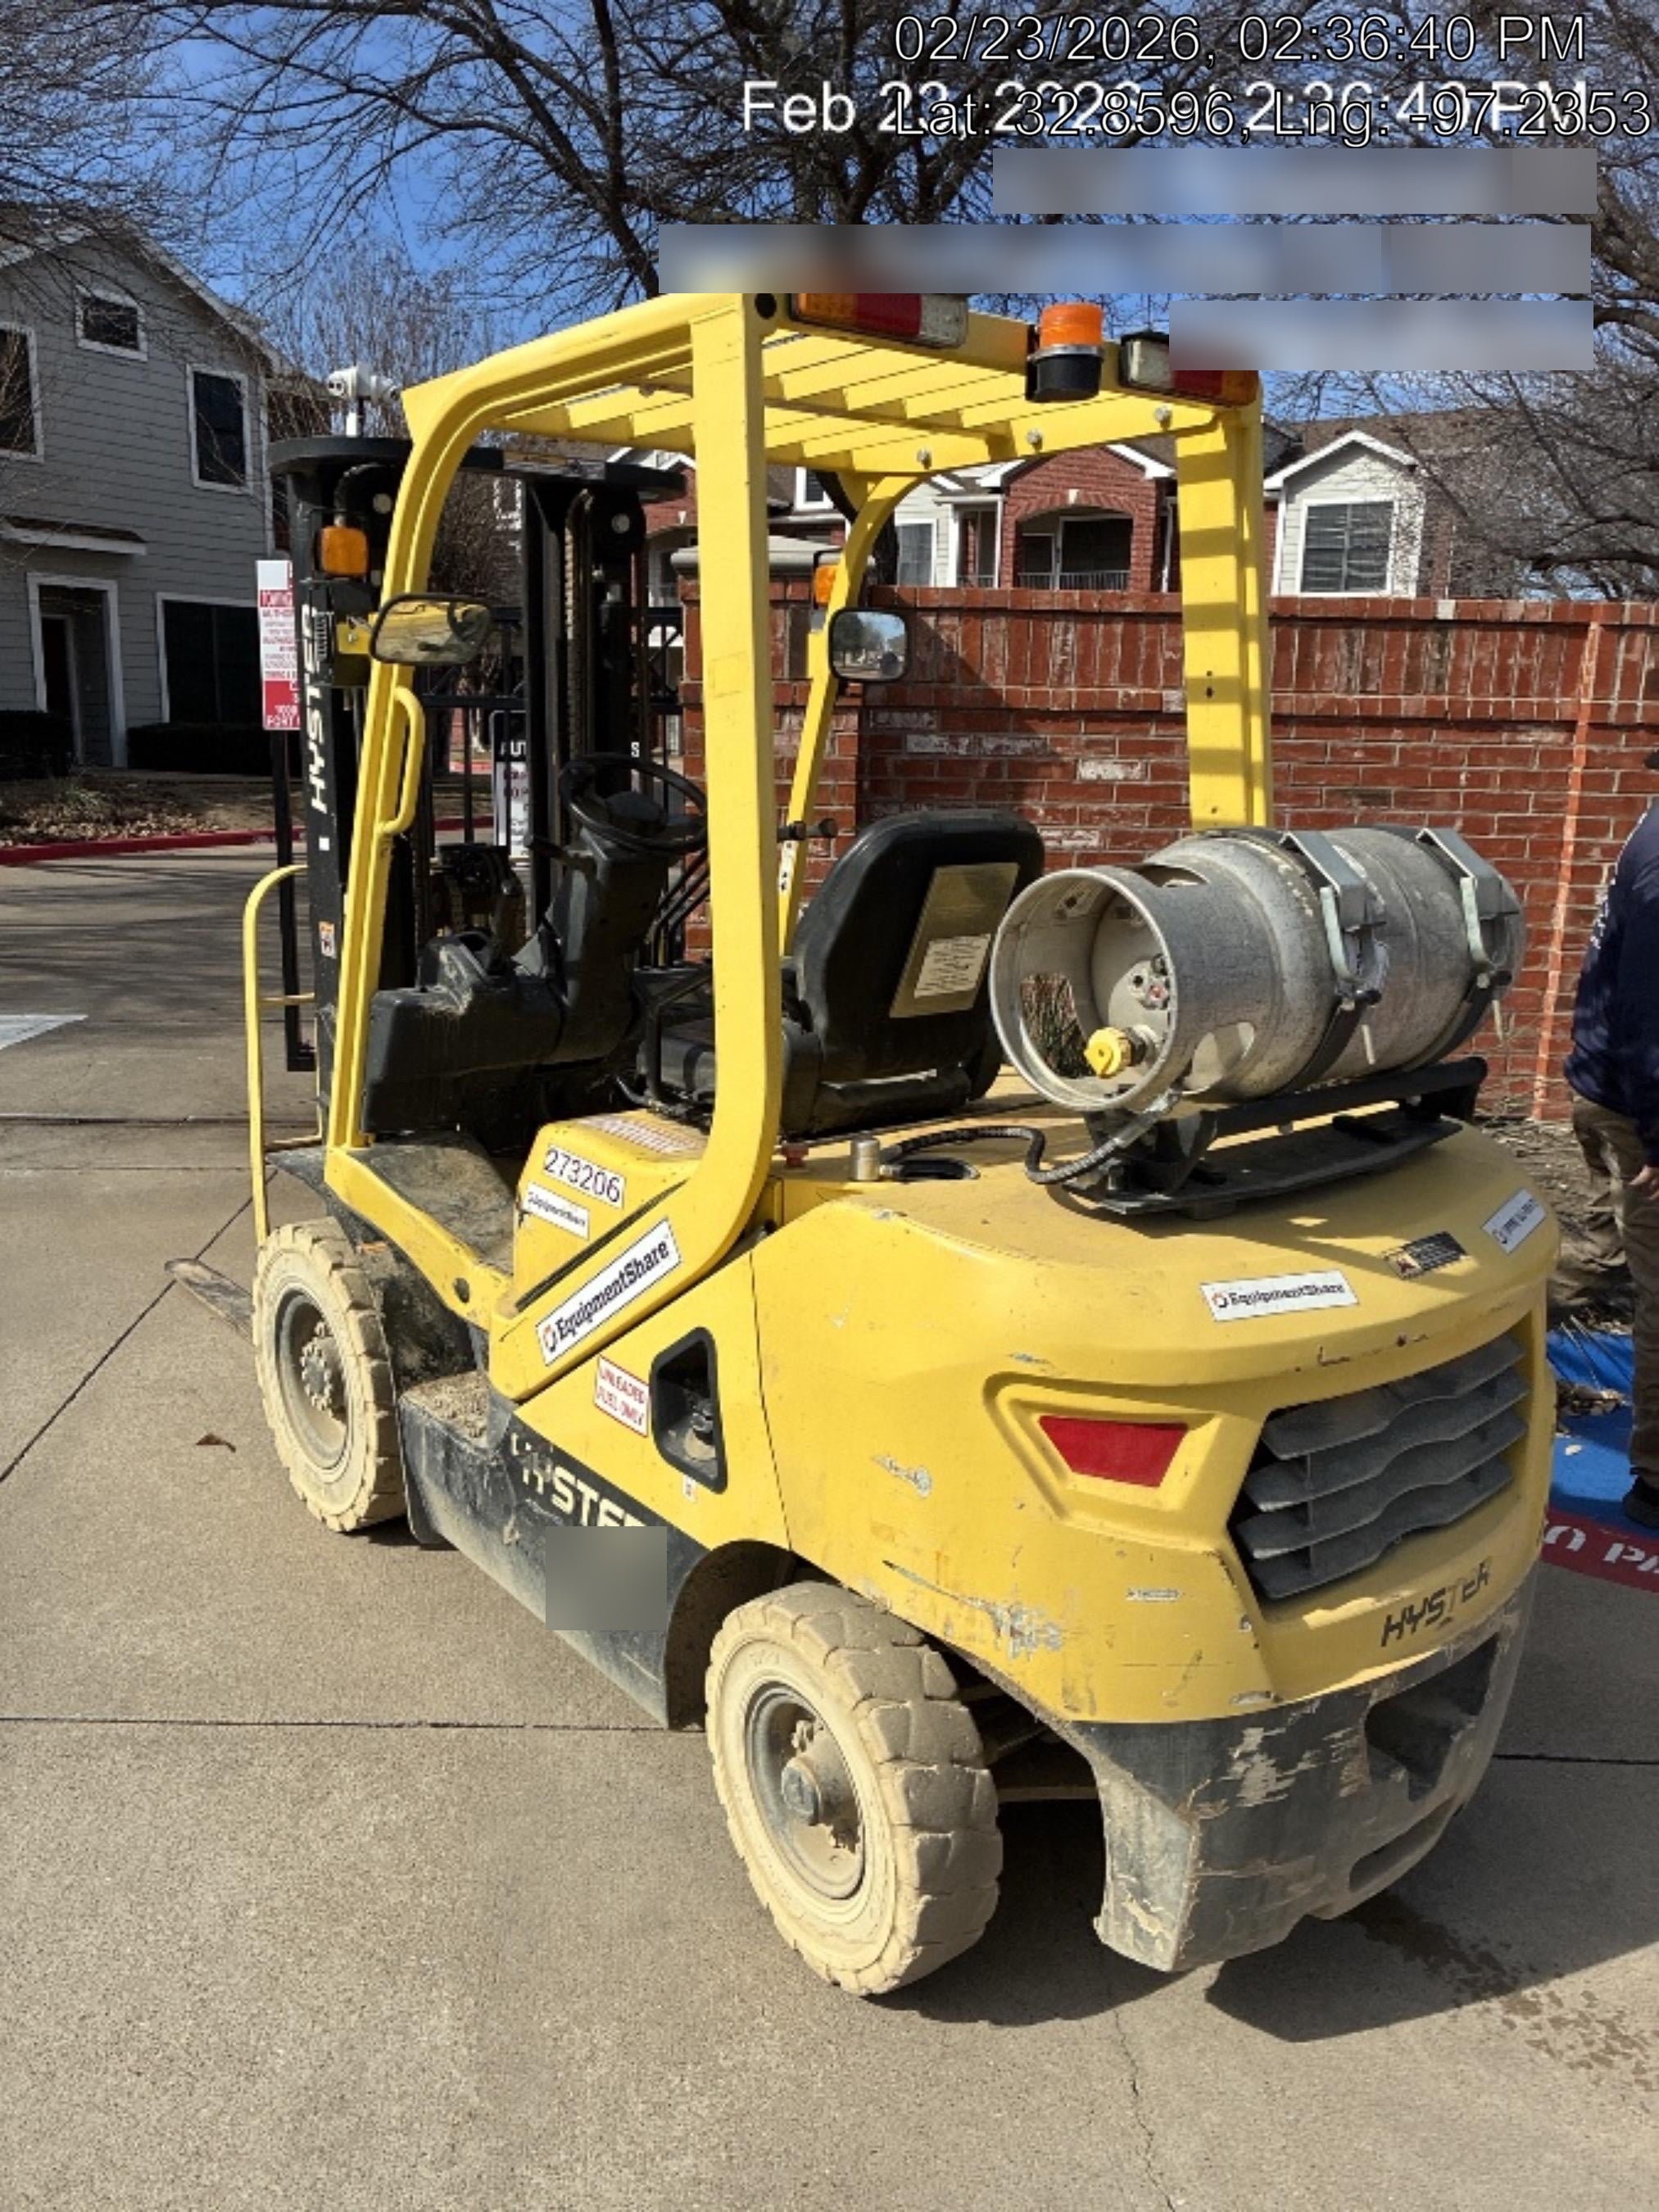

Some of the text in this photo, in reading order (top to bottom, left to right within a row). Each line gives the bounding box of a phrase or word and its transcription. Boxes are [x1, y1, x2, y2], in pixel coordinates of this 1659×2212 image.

[544, 1148, 621, 1203] 273206
[555, 1240, 670, 1340] EquipmentShare
[1228, 1284, 1345, 1306] EquipmentShare
